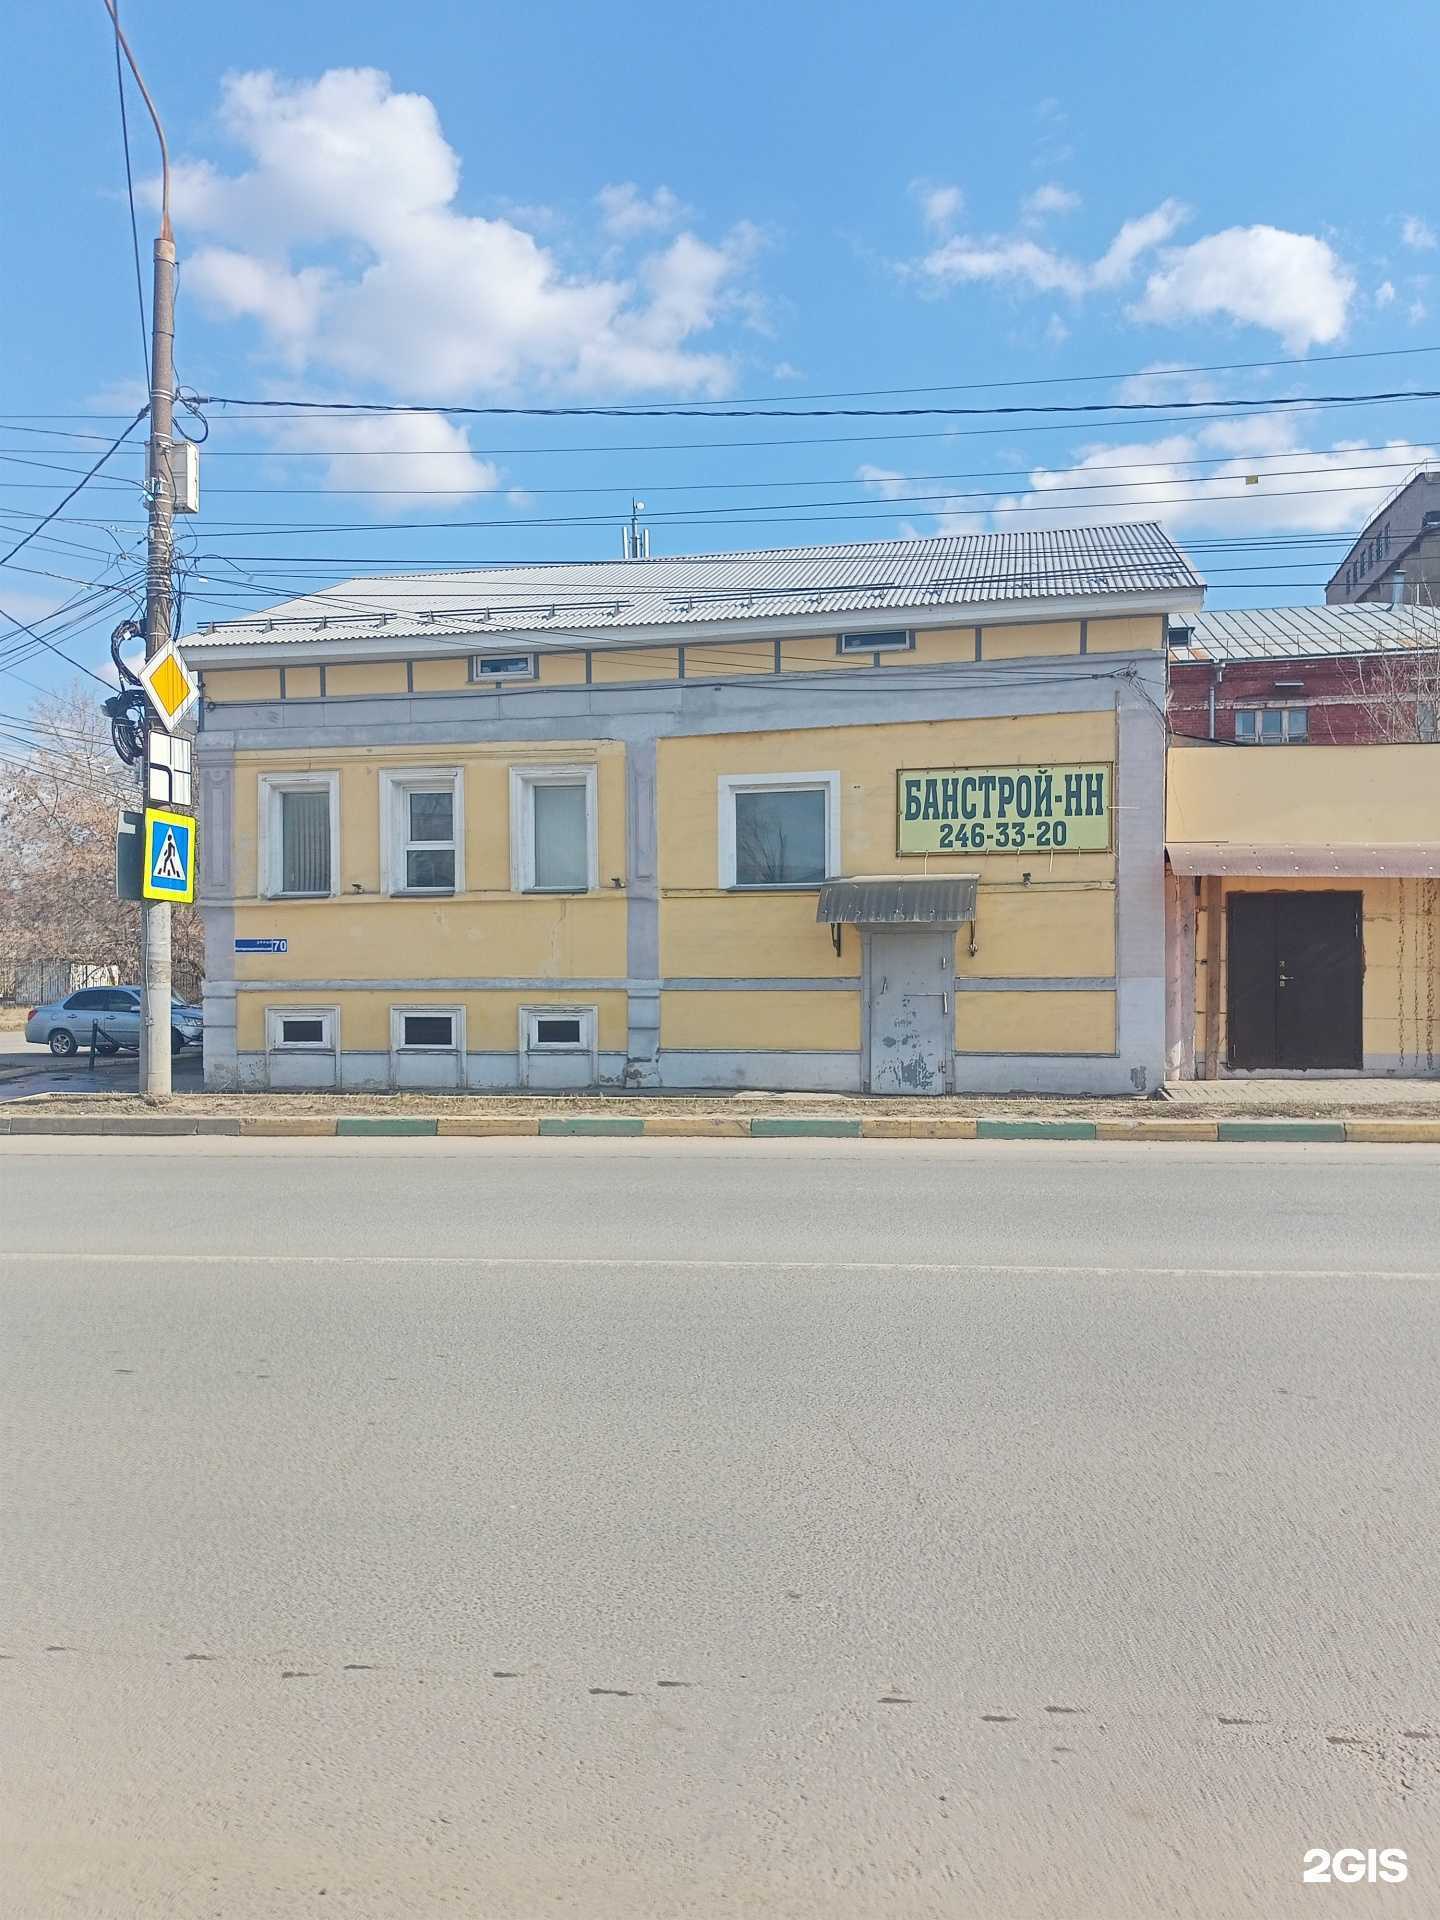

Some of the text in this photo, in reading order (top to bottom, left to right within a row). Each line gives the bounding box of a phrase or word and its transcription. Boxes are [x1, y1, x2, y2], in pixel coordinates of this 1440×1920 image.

[904, 769, 1104, 820] БАНСТРОЙ-НН
[939, 821, 1067, 848] 246-33-20
[273, 940, 286, 951] 70
